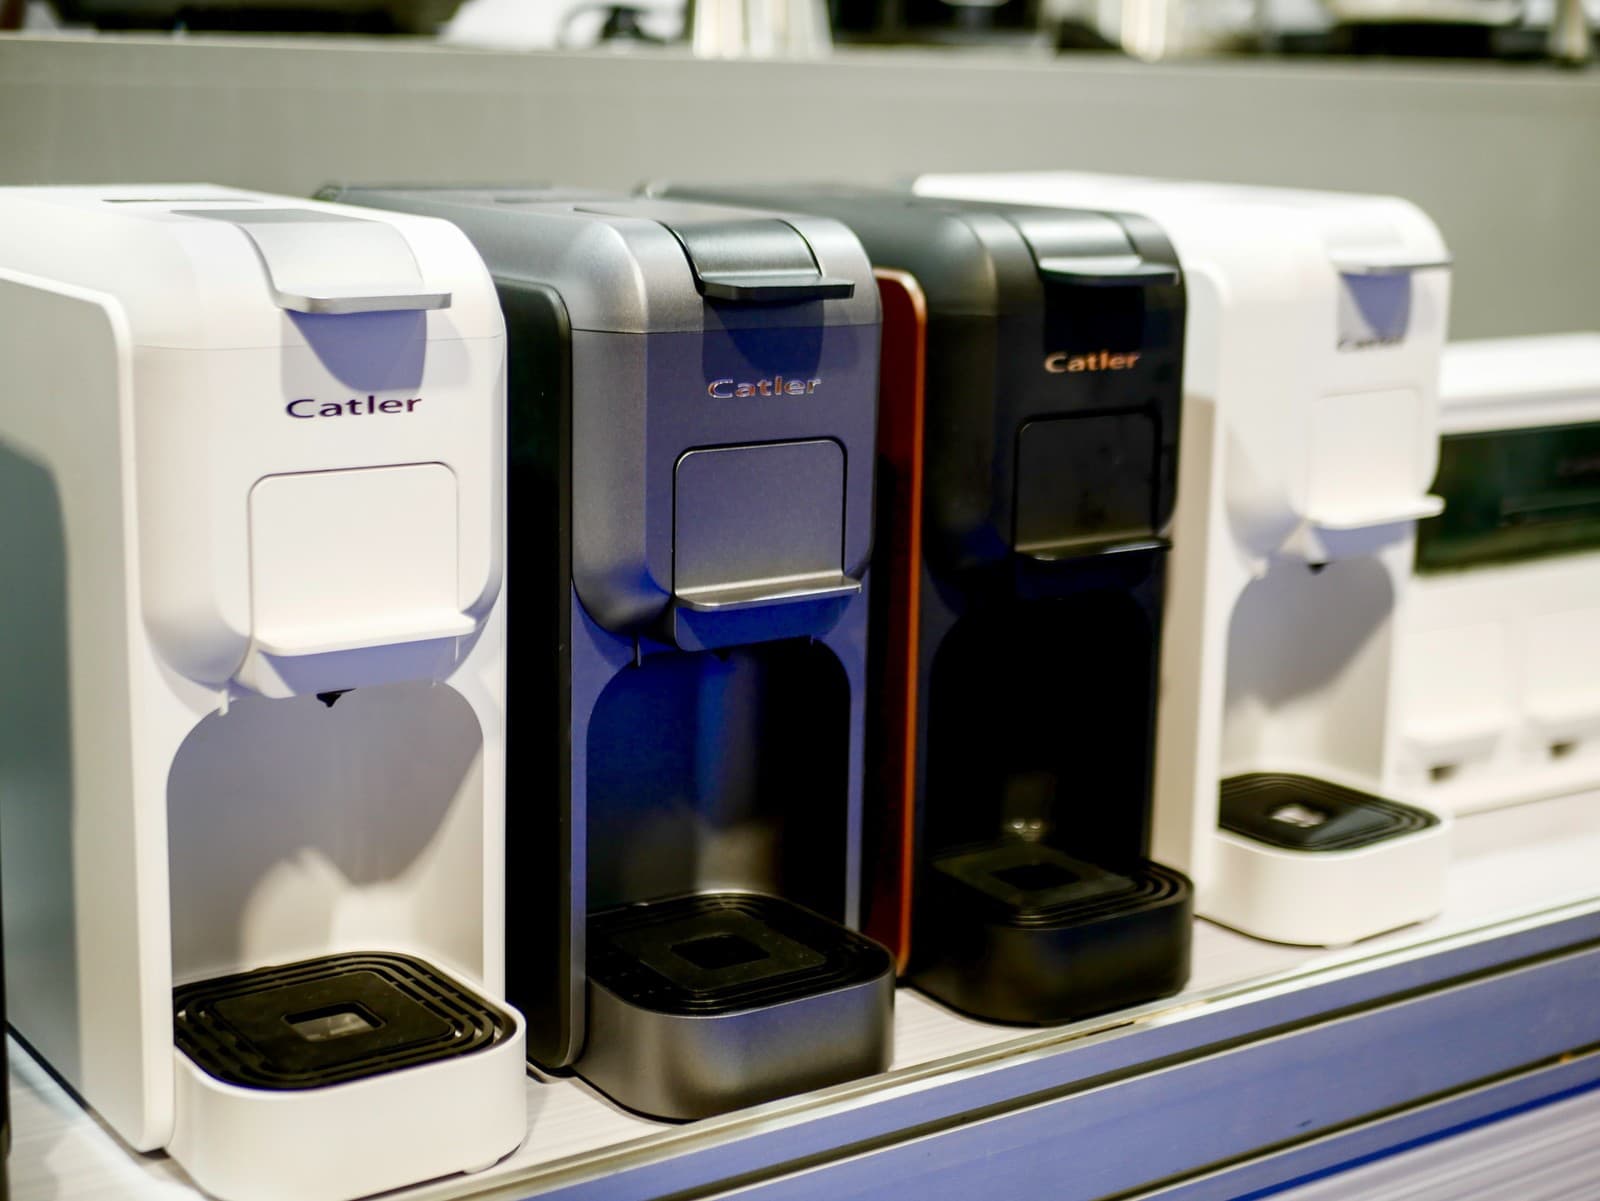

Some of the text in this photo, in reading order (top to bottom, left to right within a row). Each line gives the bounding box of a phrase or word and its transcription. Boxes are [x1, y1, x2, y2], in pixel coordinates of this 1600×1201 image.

[1044, 350, 1141, 373] Catler
[707, 376, 822, 399] Catler
[286, 394, 422, 419] Catler
